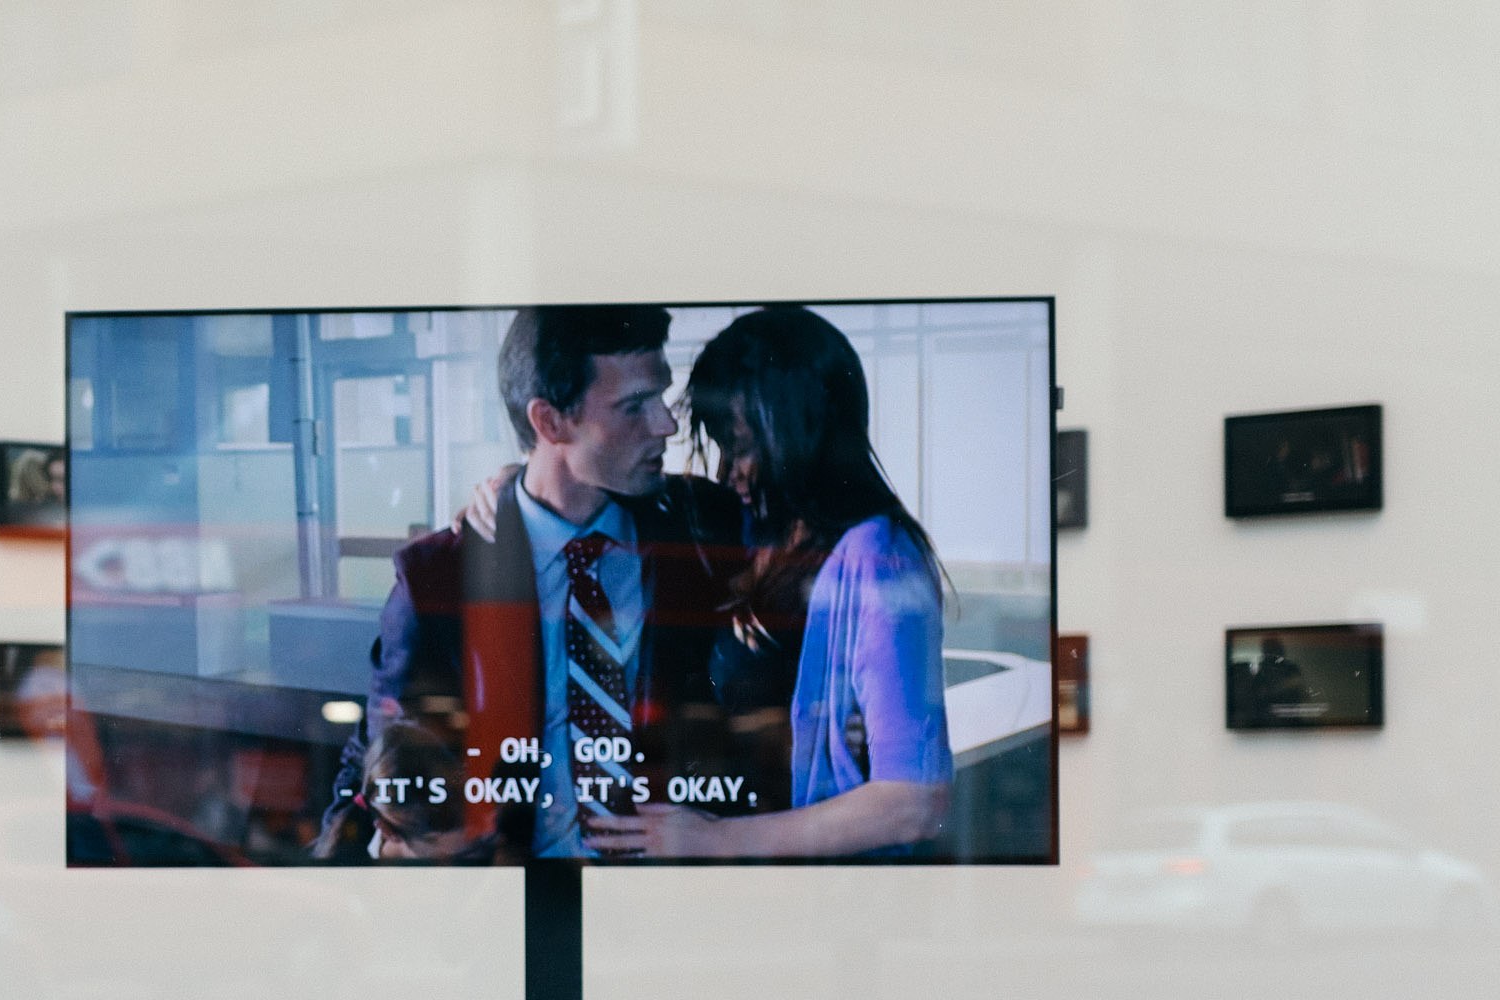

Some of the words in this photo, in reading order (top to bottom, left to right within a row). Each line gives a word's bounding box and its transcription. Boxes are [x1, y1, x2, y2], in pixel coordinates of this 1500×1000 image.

[500, 736, 554, 768] OH,
[574, 736, 646, 763] GOD.
[374, 777, 447, 803] IT'S
[464, 777, 554, 808] OKAY,
[576, 776, 651, 803] IT'S
[667, 775, 759, 804] OKAY.
